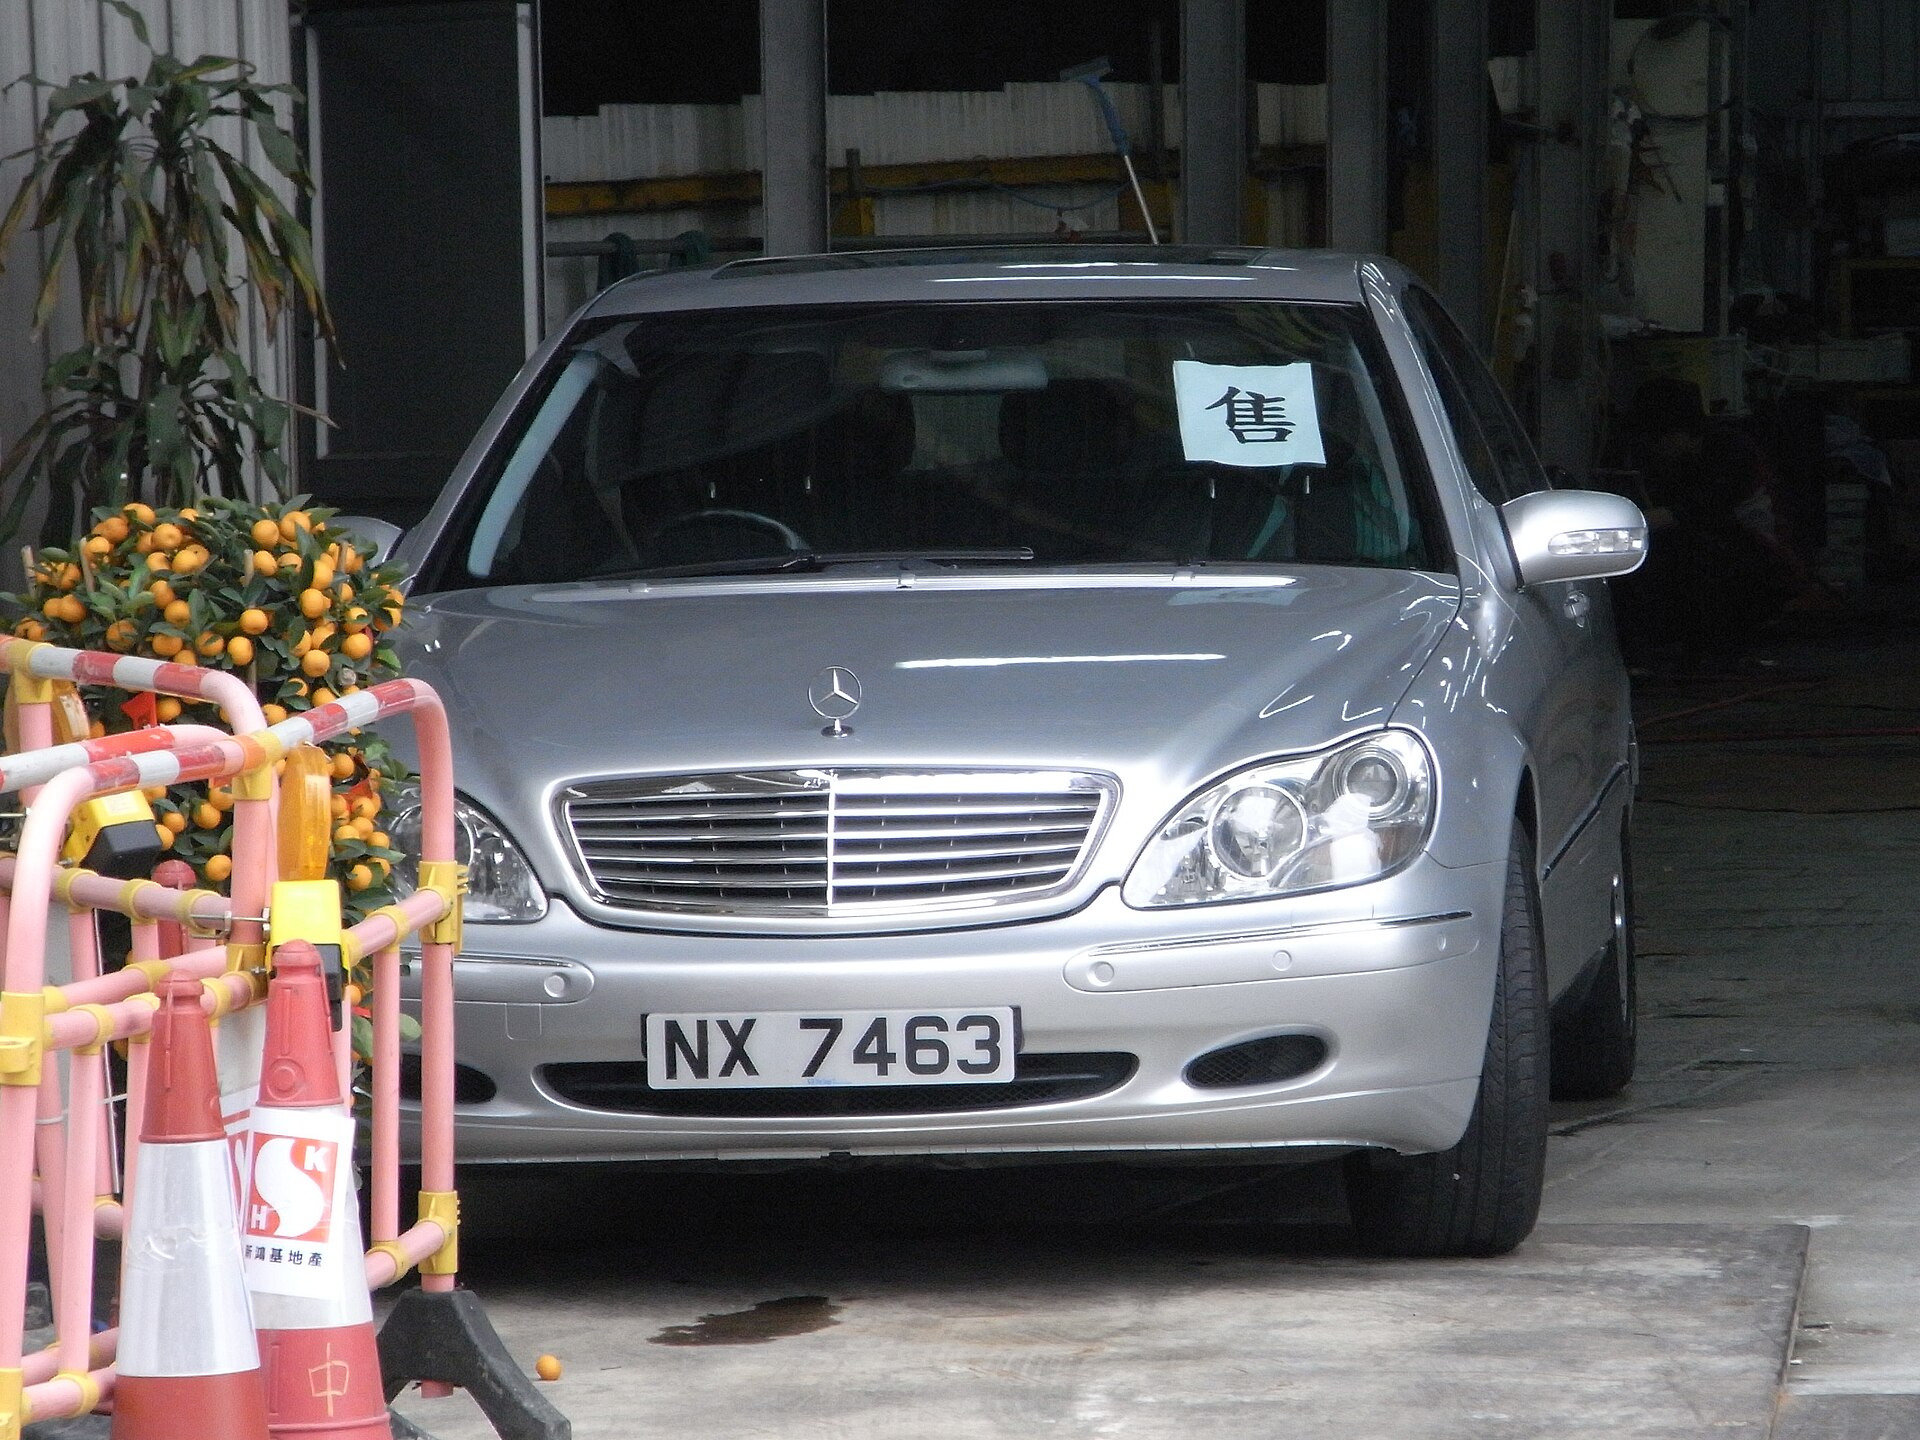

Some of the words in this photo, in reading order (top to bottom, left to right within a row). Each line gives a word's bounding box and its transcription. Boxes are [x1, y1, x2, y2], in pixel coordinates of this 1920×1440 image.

[1205, 386, 1296, 444] 售
[664, 1018, 759, 1080] NX
[800, 1015, 1001, 1077] 7463
[255, 1138, 325, 1237] S
[304, 1145, 329, 1173] K
[250, 1204, 268, 1230] H
[308, 1342, 350, 1417] 中
